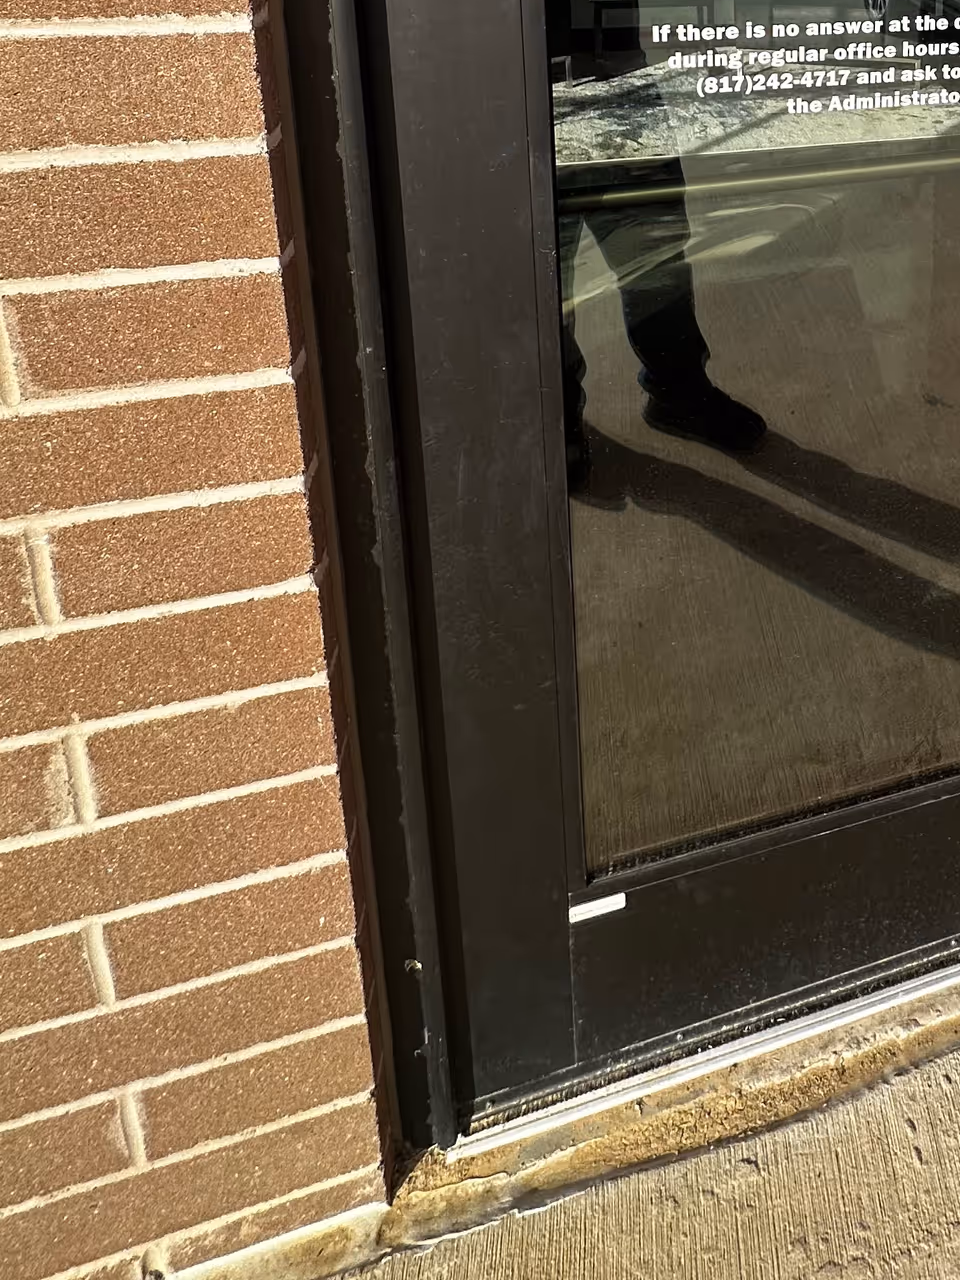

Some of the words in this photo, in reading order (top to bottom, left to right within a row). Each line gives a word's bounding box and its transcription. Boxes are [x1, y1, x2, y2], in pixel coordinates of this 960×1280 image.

[652, 24, 671, 43] If
[676, 24, 739, 41] there
[745, 22, 766, 38] is
[772, 24, 800, 38] no
[805, 19, 883, 36] answer
[888, 17, 910, 32] at
[914, 15, 949, 31] the
[667, 49, 743, 70] during
[749, 46, 828, 67] regular
[833, 42, 896, 60] office
[696, 70, 850, 97] (817)242-4717
[856, 67, 895, 85] and
[900, 65, 937, 82] ask
[786, 97, 823, 114] the
